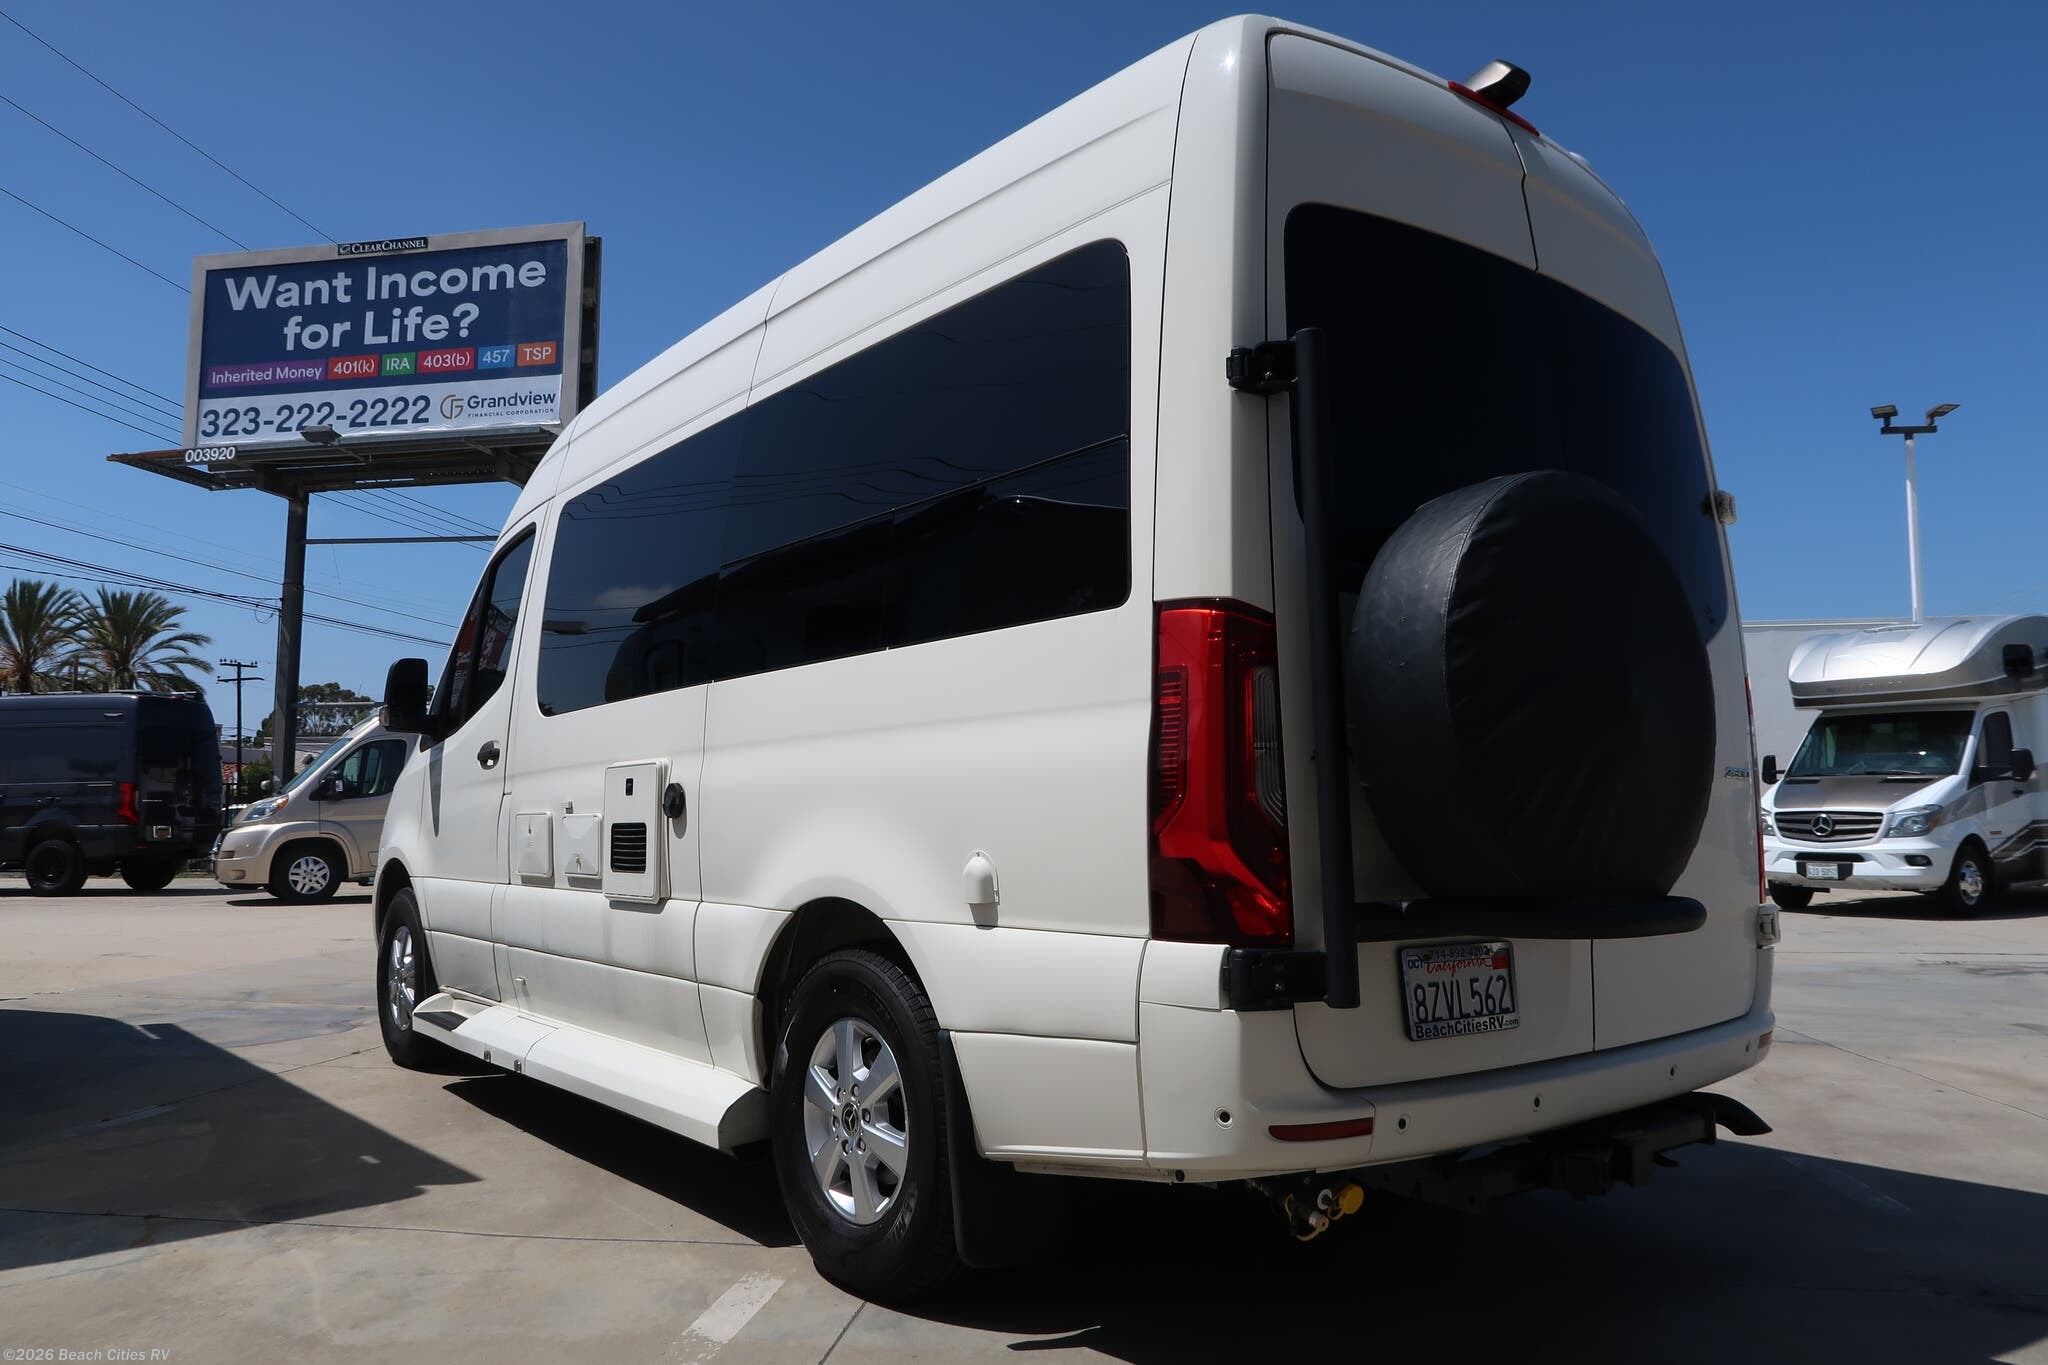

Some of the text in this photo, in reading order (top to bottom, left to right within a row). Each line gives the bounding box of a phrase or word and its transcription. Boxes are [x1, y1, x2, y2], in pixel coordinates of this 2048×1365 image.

[225, 260, 547, 311] Want Income
[283, 303, 480, 351] for Life?
[423, 353, 470, 369] 403(b)
[482, 350, 510, 364] 457
[523, 347, 552, 361] TSP
[333, 357, 375, 375] 401(k)
[386, 357, 410, 371] IRA
[212, 366, 322, 385] Inherited Money
[467, 391, 557, 410] Grandview
[200, 394, 431, 438] 323-222-2222
[467, 408, 555, 418] FINANCIAL CORPORATION
[184, 446, 236, 462] 003920
[1413, 974, 1511, 1022] 8ZVL562
[1415, 1015, 1519, 1039] BeachCitiesRV.com
